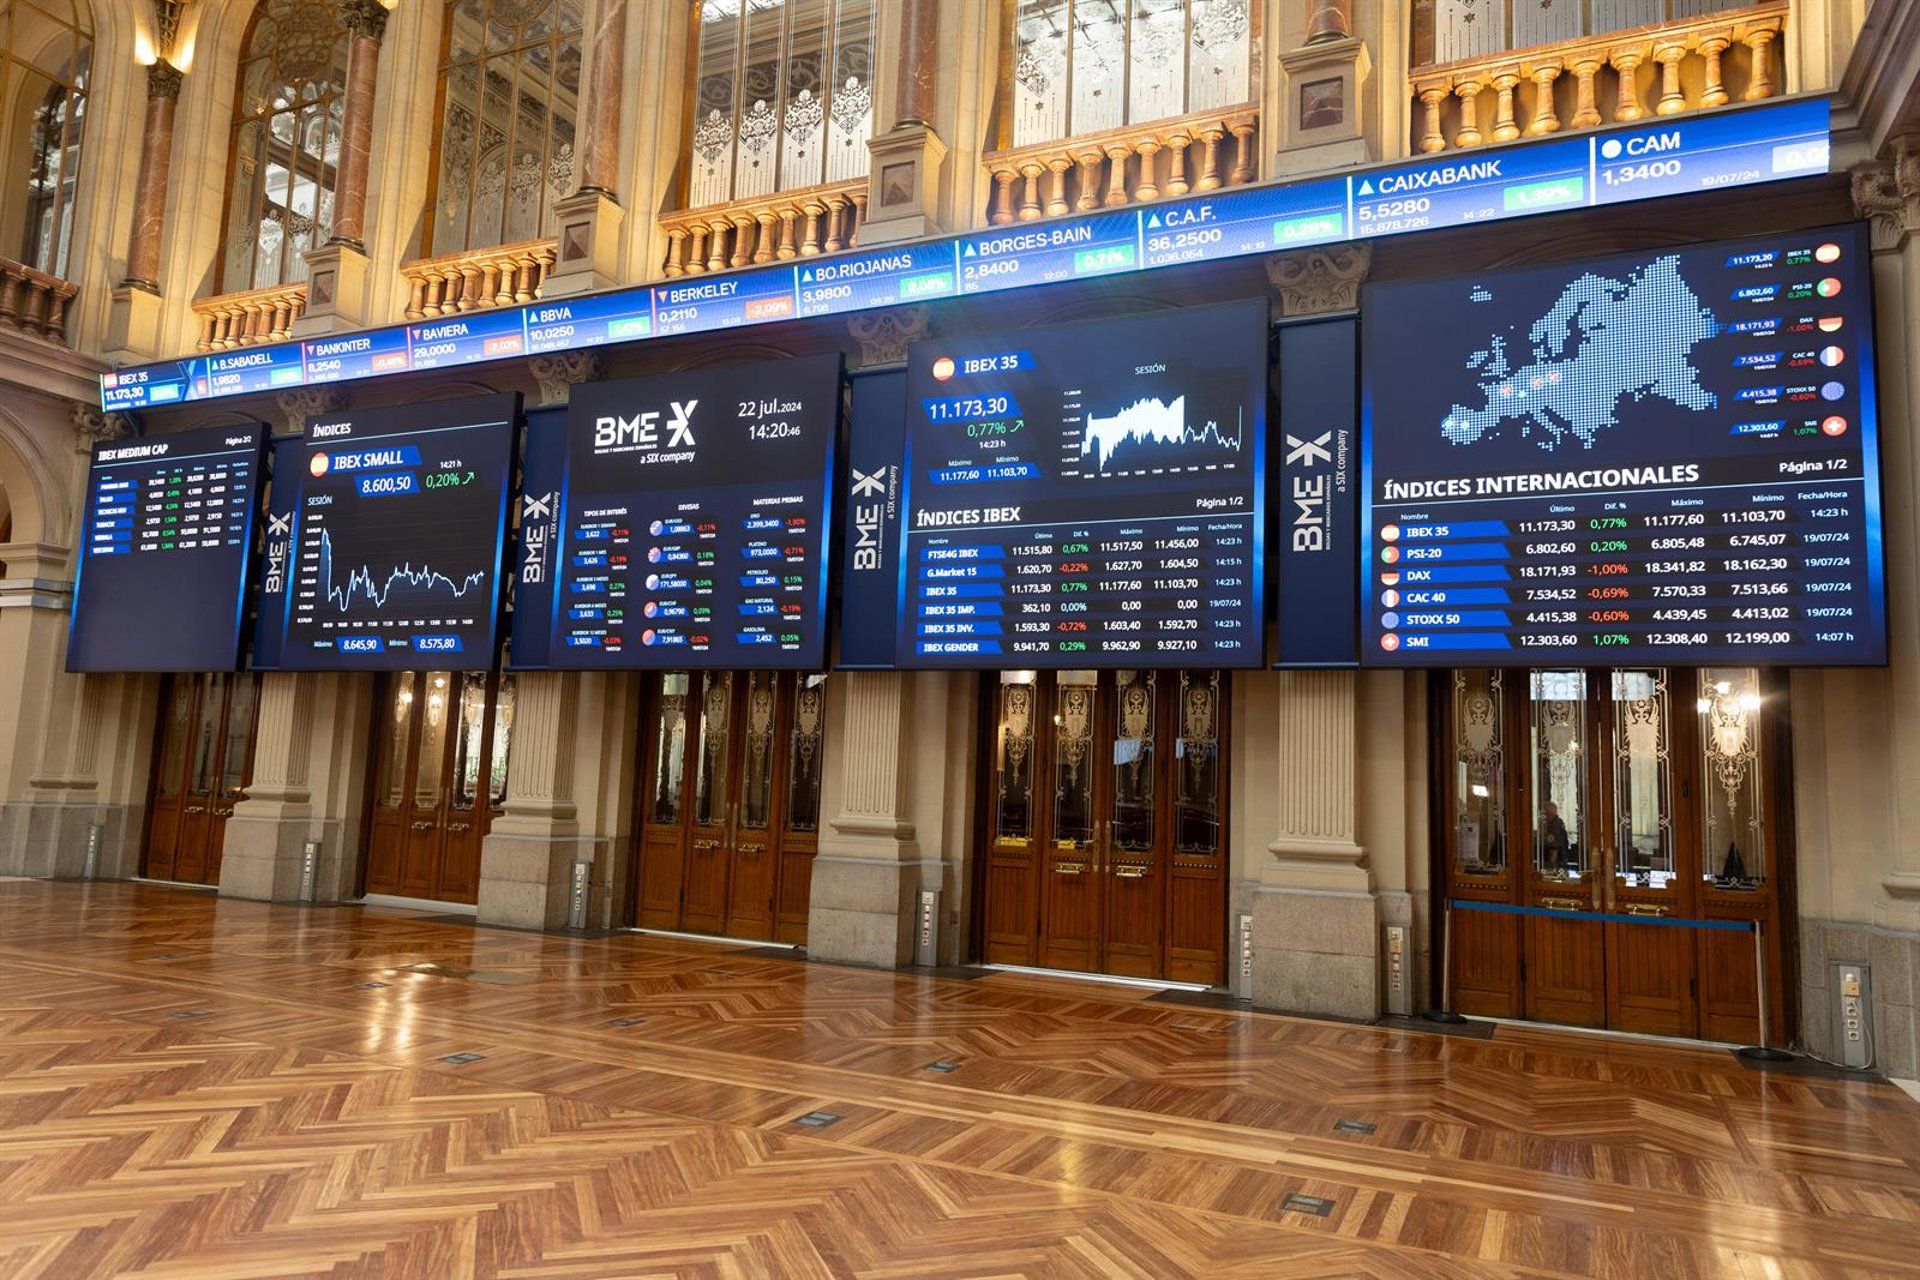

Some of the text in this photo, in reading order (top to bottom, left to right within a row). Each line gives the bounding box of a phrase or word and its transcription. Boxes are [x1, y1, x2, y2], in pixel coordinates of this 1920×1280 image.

[1627, 132, 1680, 155] CAM
[1379, 160, 1501, 194] CAIXABANK
[1602, 159, 1680, 186] 1,3400
[1358, 198, 1430, 221] 5,5280
[1165, 206, 1216, 227] C.A.F.
[979, 226, 1091, 256] BORGES-BAIN
[1148, 229, 1222, 252] 36,2500
[815, 255, 912, 282] BO.RIOJANAS
[965, 260, 1019, 279] 2,8400
[671, 282, 738, 302] BERKELEY
[803, 286, 851, 302] 3,9800
[540, 307, 571, 322] BBVA
[659, 308, 697, 322] 0,2110
[423, 324, 468, 340] BAVIERA
[530, 326, 574, 340] 10,0250
[316, 338, 370, 356] BANKINTER
[220, 353, 272, 369] B.SABADELL
[965, 356, 1018, 373] IBEX 35
[1135, 364, 1165, 375] SESIÓN
[119, 372, 148, 385] IBEX 35
[738, 402, 755, 417] 22
[930, 398, 1007, 420] 11.173,30
[313, 424, 351, 437] ÍNDICES
[749, 422, 800, 439] 14:20:46
[967, 423, 1006, 438] 0,77%
[118, 446, 150, 459] MEDIUM
[152, 444, 168, 455] CAP
[1338, 430, 1348, 469] company
[334, 451, 403, 469] IBEX SMALL
[647, 454, 659, 463] SIX
[660, 451, 695, 463] company
[988, 467, 1027, 478] 11.103,70
[1780, 459, 1847, 474] Página 1/2
[426, 473, 459, 488] 0,20%
[940, 470, 979, 481] 11.177,60
[1336, 471, 1345, 485] SIX
[363, 476, 410, 492] 8.600,50
[1384, 464, 1700, 500] ÍNDICES INTERNACIONALES
[308, 495, 332, 506] SESIÓN
[1196, 497, 1243, 509] Página 1/2
[917, 507, 1020, 526] ÍNDICES IBEX
[1293, 475, 1323, 551] BME
[1722, 510, 1784, 523] 11.103,70
[1810, 508, 1848, 518] 14:23 h
[1519, 520, 1575, 533] 11.173,30
[1590, 518, 1626, 530] 0,77%
[1644, 514, 1704, 527] 11.177,60
[854, 504, 878, 569] BME
[1407, 527, 1449, 537] IBEX 35
[1804, 533, 1849, 543] 19/07/24
[1155, 539, 1198, 549] 11.456,00
[1651, 537, 1704, 550] 6.805,48
[1730, 534, 1786, 546] 6.745,07
[1013, 546, 1052, 555] 11.515,80
[1062, 544, 1088, 553] 0,67%
[1100, 542, 1142, 551] 11.517,50
[1526, 543, 1576, 555] 6.802,60
[1590, 541, 1627, 553] 0,20%
[523, 526, 544, 583] BME
[959, 549, 978, 557] IBEX
[1407, 549, 1441, 558] PSI-20
[265, 542, 283, 593] BME
[1059, 564, 1088, 572] -0,22%
[1105, 561, 1142, 570] 1.627,70
[1160, 559, 1198, 568] 1.604,50
[1645, 561, 1705, 574] 18.341,82
[1723, 558, 1787, 571] 18.162,30
[1804, 558, 1850, 567] 19/07/24
[928, 568, 976, 577] G.Market 15
[1017, 565, 1051, 574] 1.620,70
[1407, 571, 1430, 580] DAX
[1520, 566, 1576, 578] 18.171,93
[1587, 565, 1628, 576] -1,00%
[1011, 584, 1051, 593] 11.173,30
[1062, 582, 1087, 592] 0,77%
[1100, 581, 1141, 590] 11.177,60
[1154, 579, 1198, 589] 11.103,70
[1731, 583, 1788, 595] 7.513,66
[1805, 582, 1851, 592] 19/07/24
[947, 587, 956, 595] 35
[1527, 589, 1576, 601] 7.534,52
[1588, 588, 1628, 599] -0,69%
[1652, 586, 1706, 598] 7.570,33
[1407, 592, 1445, 603] CAC 40
[946, 606, 956, 614] 35
[1022, 604, 1050, 613] 362,10
[1061, 603, 1086, 612] 0,00%
[1122, 601, 1141, 610] 0,00
[1178, 600, 1198, 610] 0,00
[1527, 612, 1577, 624] 4.415,38
[1588, 611, 1629, 622] -0,60%
[1653, 609, 1707, 621] 4.439,45
[1732, 607, 1789, 620] 4.413,02
[1806, 608, 1852, 617] 19/07/24
[1104, 621, 1140, 630] 1.603,40
[1159, 620, 1197, 629] 1.592,70
[1406, 615, 1460, 624] STOXX 50
[957, 624, 974, 632] INV.
[1015, 623, 1050, 632] 1.593,30
[1057, 622, 1086, 631] -0,72%
[420, 638, 455, 648] 8.575,80
[1406, 637, 1429, 647] SMI
[1520, 635, 1577, 647] 12.303,60
[1593, 635, 1629, 646] 1,07%
[1647, 633, 1708, 645] 12.308,40
[1726, 632, 1789, 645] 12.199,00
[1816, 632, 1853, 642] 14:07 h
[924, 643, 978, 652] IBEX GENDER
[1014, 643, 1049, 651] 9.941,70
[1060, 642, 1086, 651] 0,29%
[1103, 641, 1140, 650] 9.962,90
[1158, 640, 1197, 650] 9.927,10
